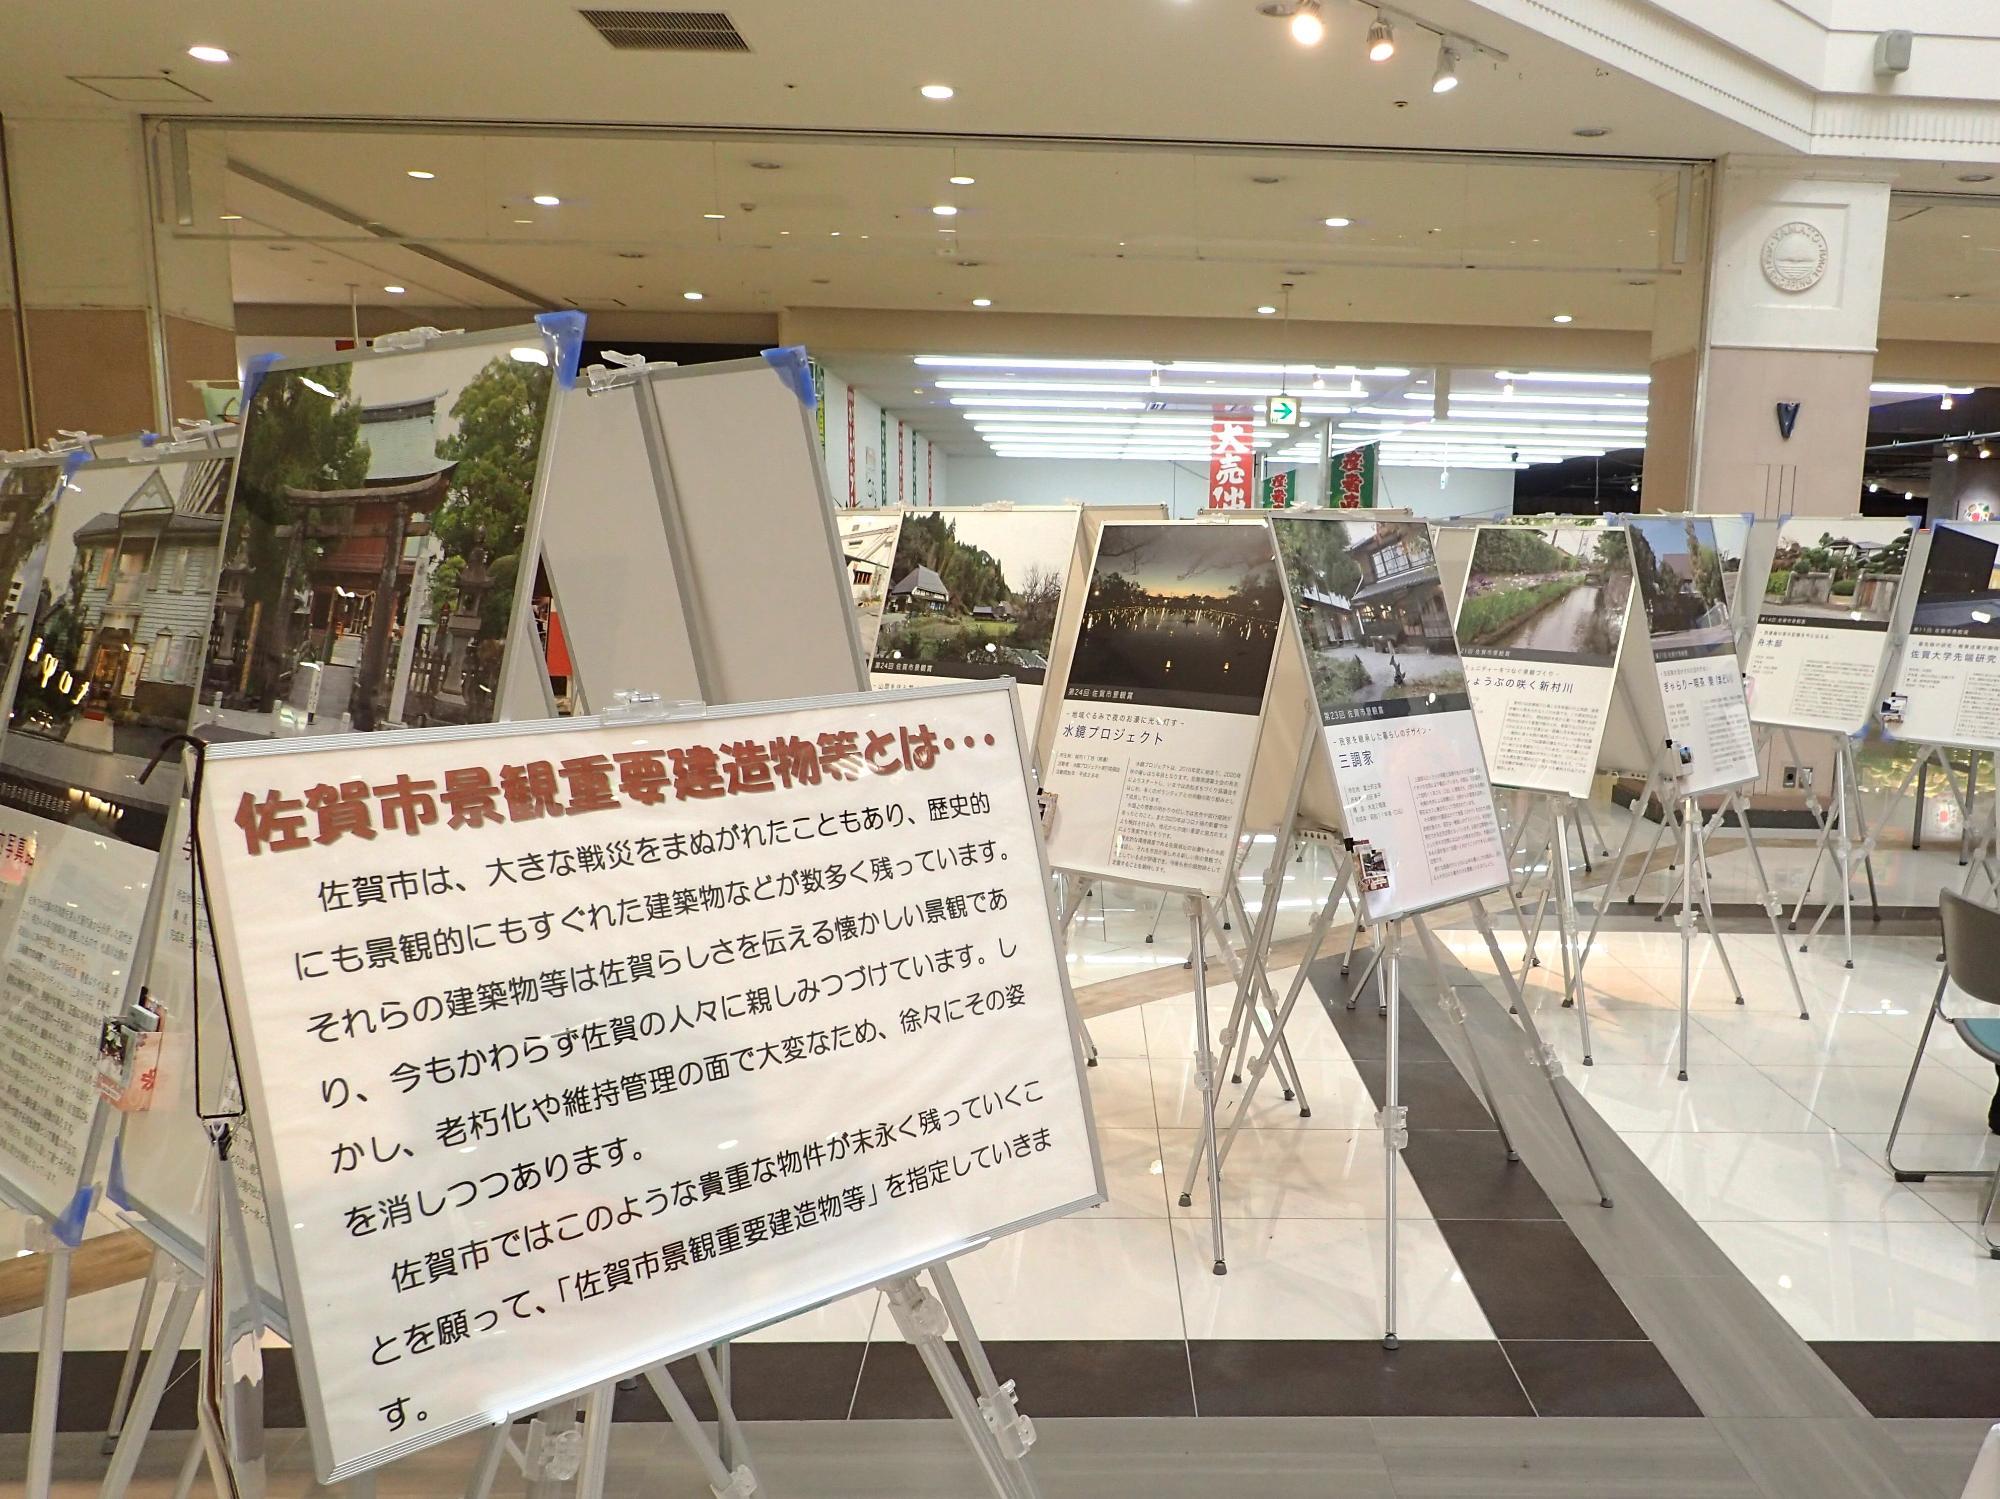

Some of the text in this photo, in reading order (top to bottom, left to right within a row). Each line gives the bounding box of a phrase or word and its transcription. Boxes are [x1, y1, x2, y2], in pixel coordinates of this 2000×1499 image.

[1062, 725, 1164, 746] 水鏡プロジェクト
[294, 839, 1009, 981] にも景観的にもすぐれた建築物などが数多く残っています。
[317, 791, 990, 913] 佐賀市は、大きな戦災をまぬがれたこともあり、歴史的
[306, 888, 1008, 1043] それらの建築物等は佐賀らしさを伝える懐かしい景観であ
[321, 938, 1017, 1109] り、今もかわらず佐賀の人々に親しみつづけています。し
[331, 983, 1026, 1174] かし、老朽化や維持管理の面で大変なため、徐々にその姿
[344, 1137, 644, 1238] を消しつつあります。
[370, 1127, 1052, 1366] とを願って、「佐賀市景観重要建造物等」を指定していきま
[391, 1080, 1044, 1293] 佐賀市ではこのような貴重な物件が末永く残っていくこ
[379, 1397, 428, 1431] す。
